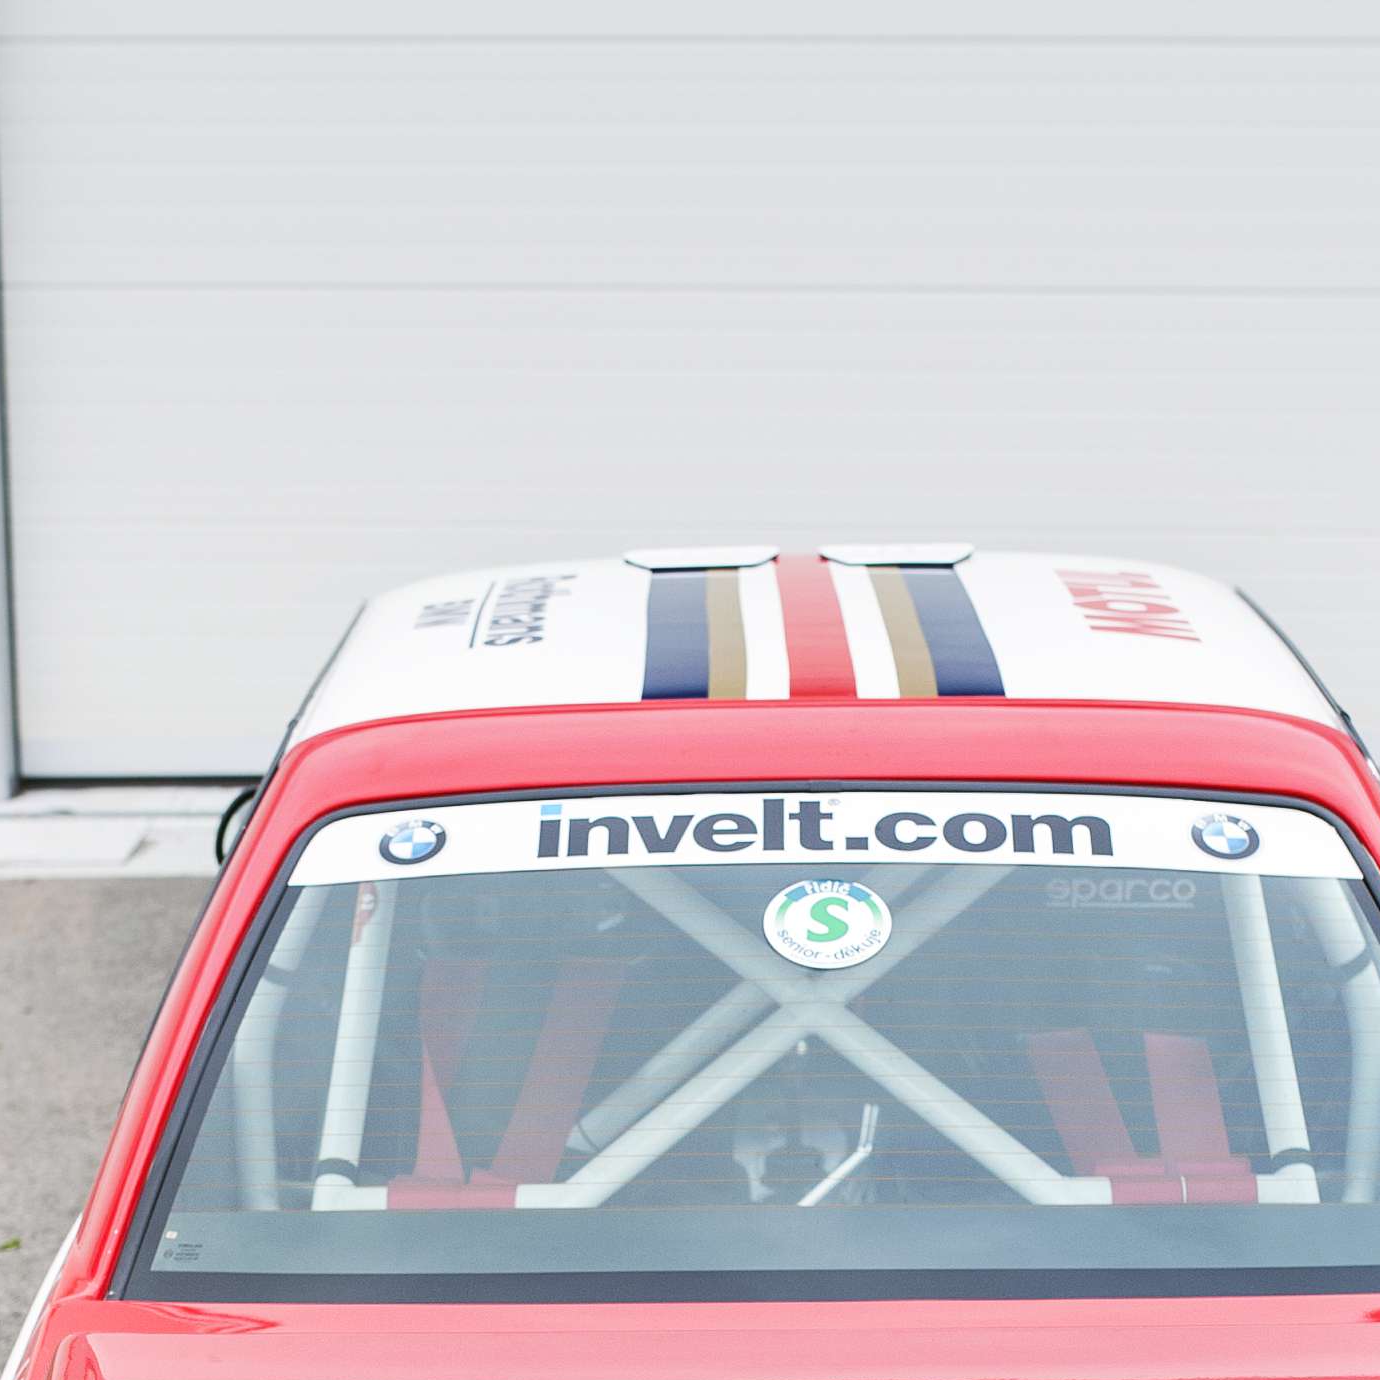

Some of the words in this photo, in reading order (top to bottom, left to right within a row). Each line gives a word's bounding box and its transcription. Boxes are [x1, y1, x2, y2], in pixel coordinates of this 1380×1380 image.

[1054, 570, 1202, 641] MOTUL
[537, 798, 1114, 856] invelt.com
[1047, 877, 1197, 906] sparco
[807, 897, 849, 942] S
[777, 929, 819, 959] senior
